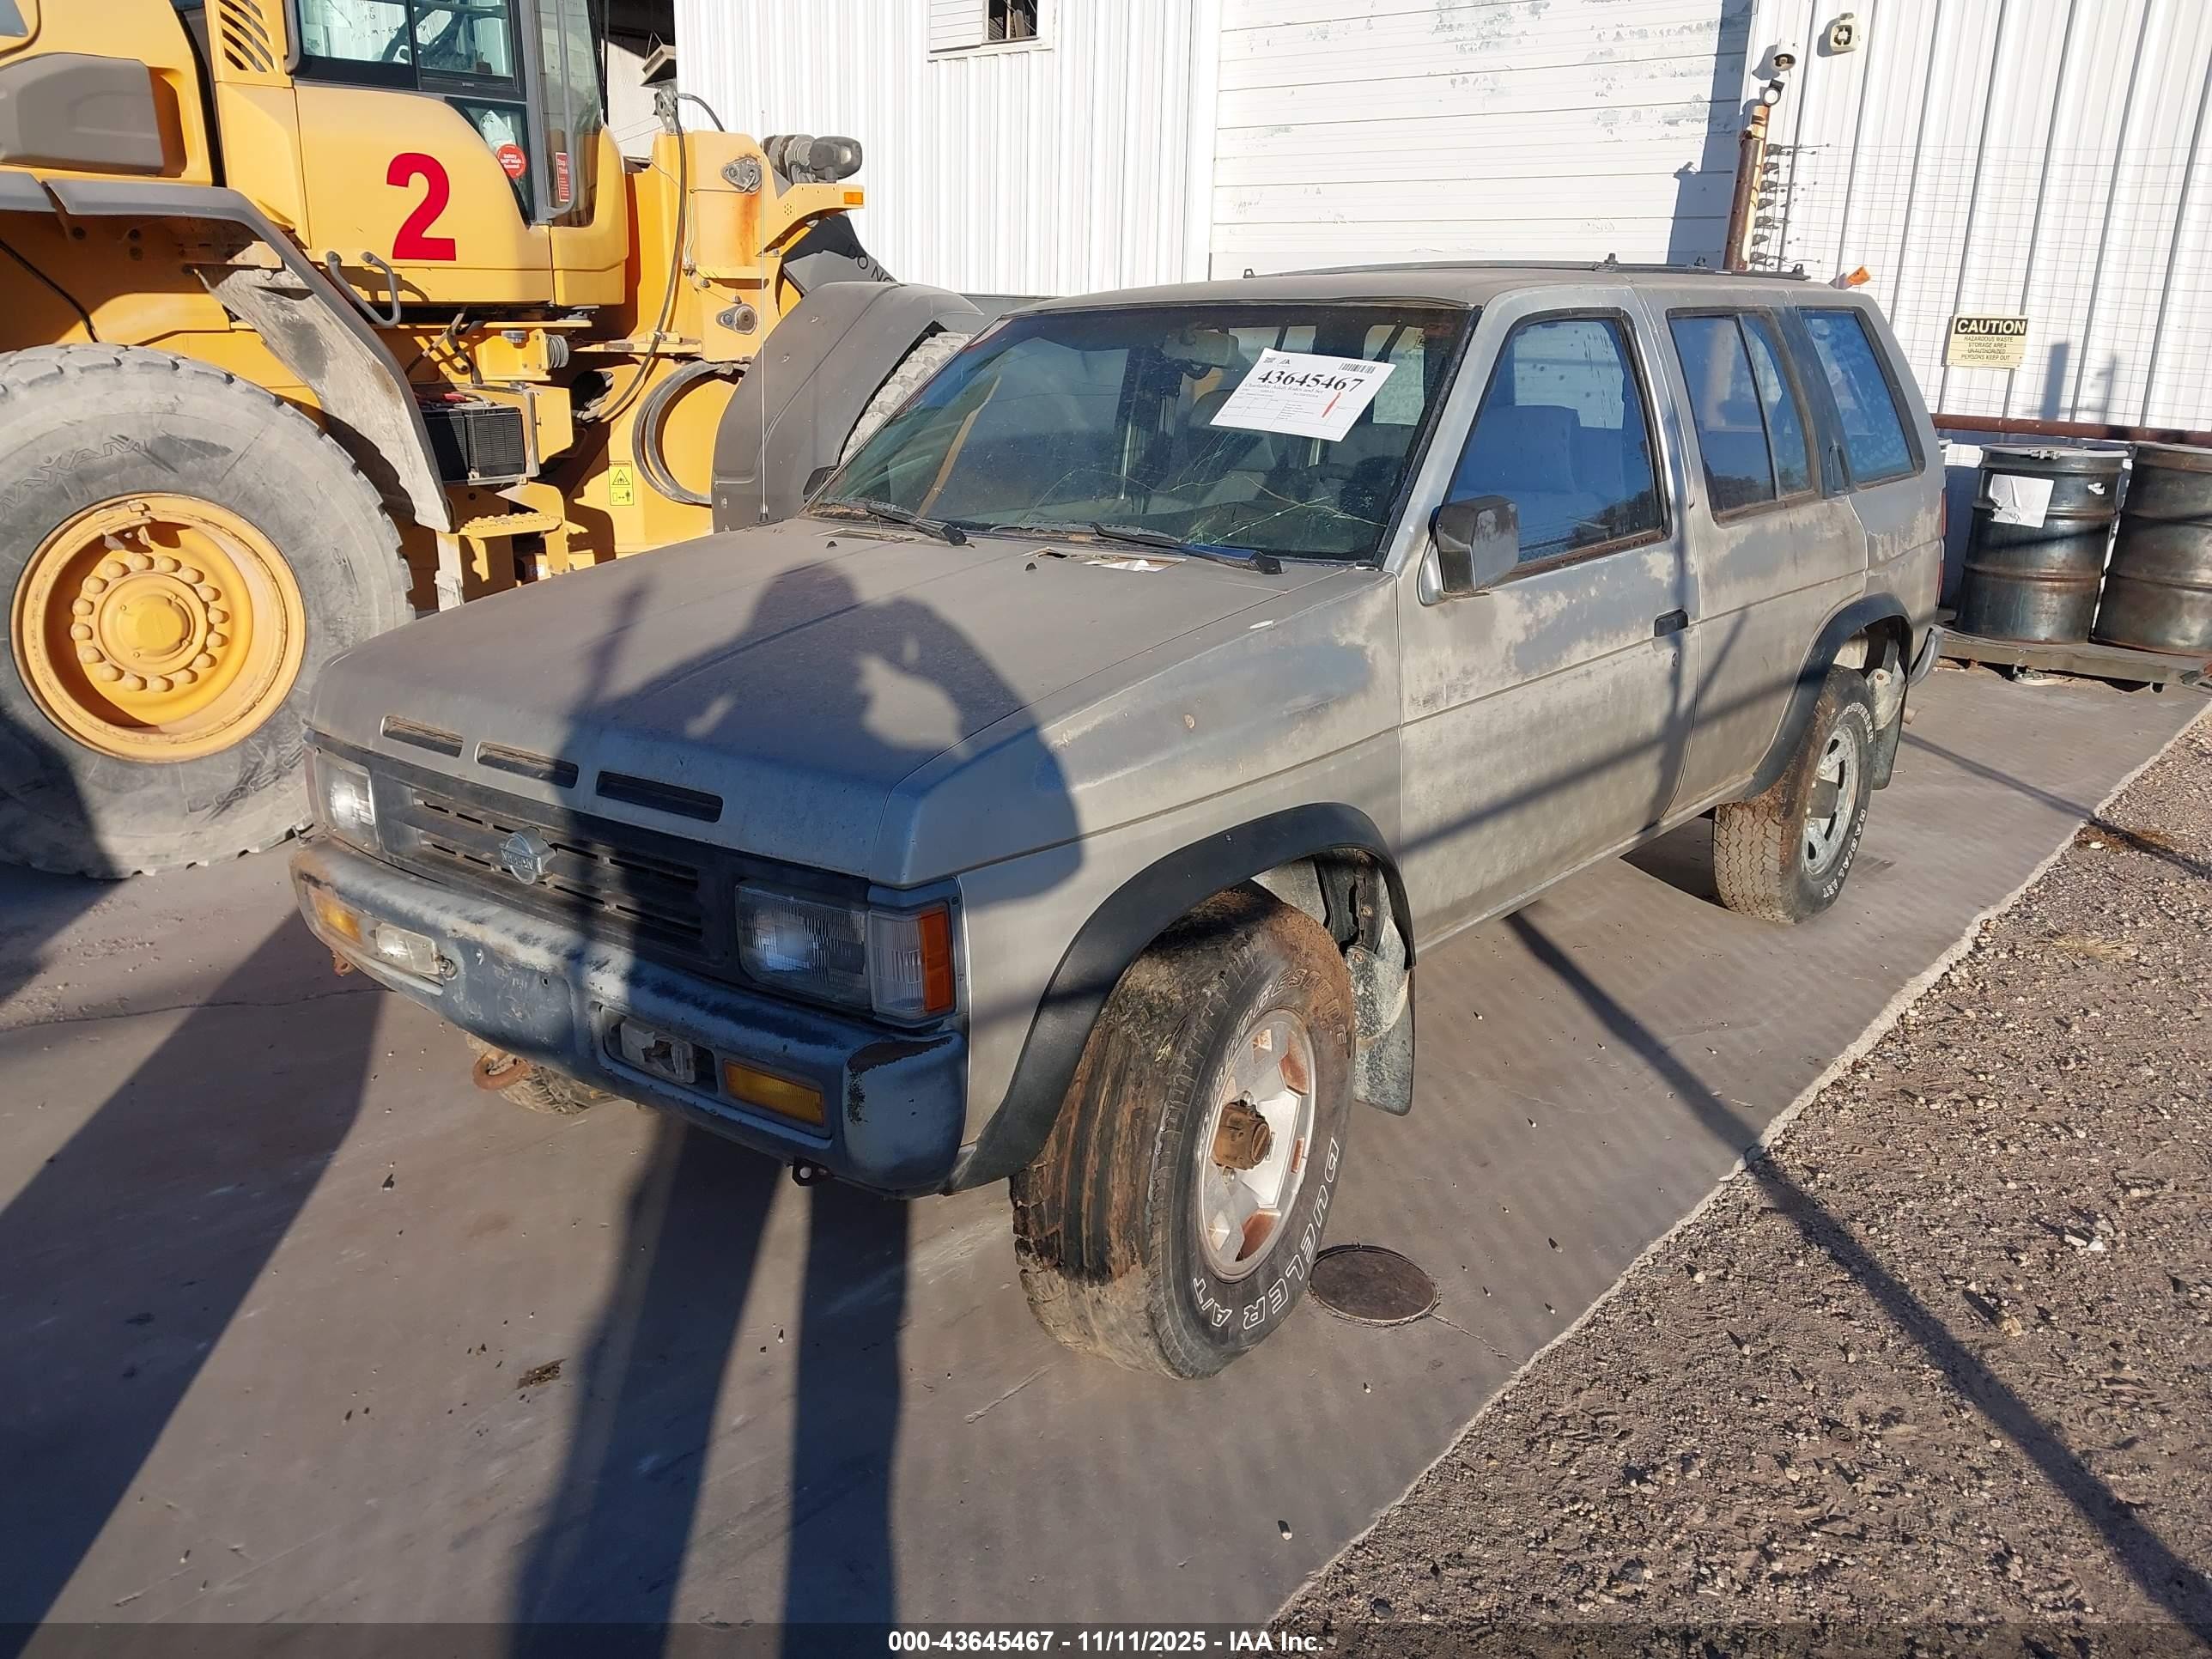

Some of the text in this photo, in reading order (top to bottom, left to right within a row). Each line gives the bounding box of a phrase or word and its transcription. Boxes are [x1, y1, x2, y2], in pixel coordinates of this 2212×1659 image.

[386, 152, 457, 261] 2
[1957, 319, 2026, 334] CAUTION
[1257, 369, 1365, 392] 43645467
[1193, 1136, 1340, 1330] DUELER A/T
